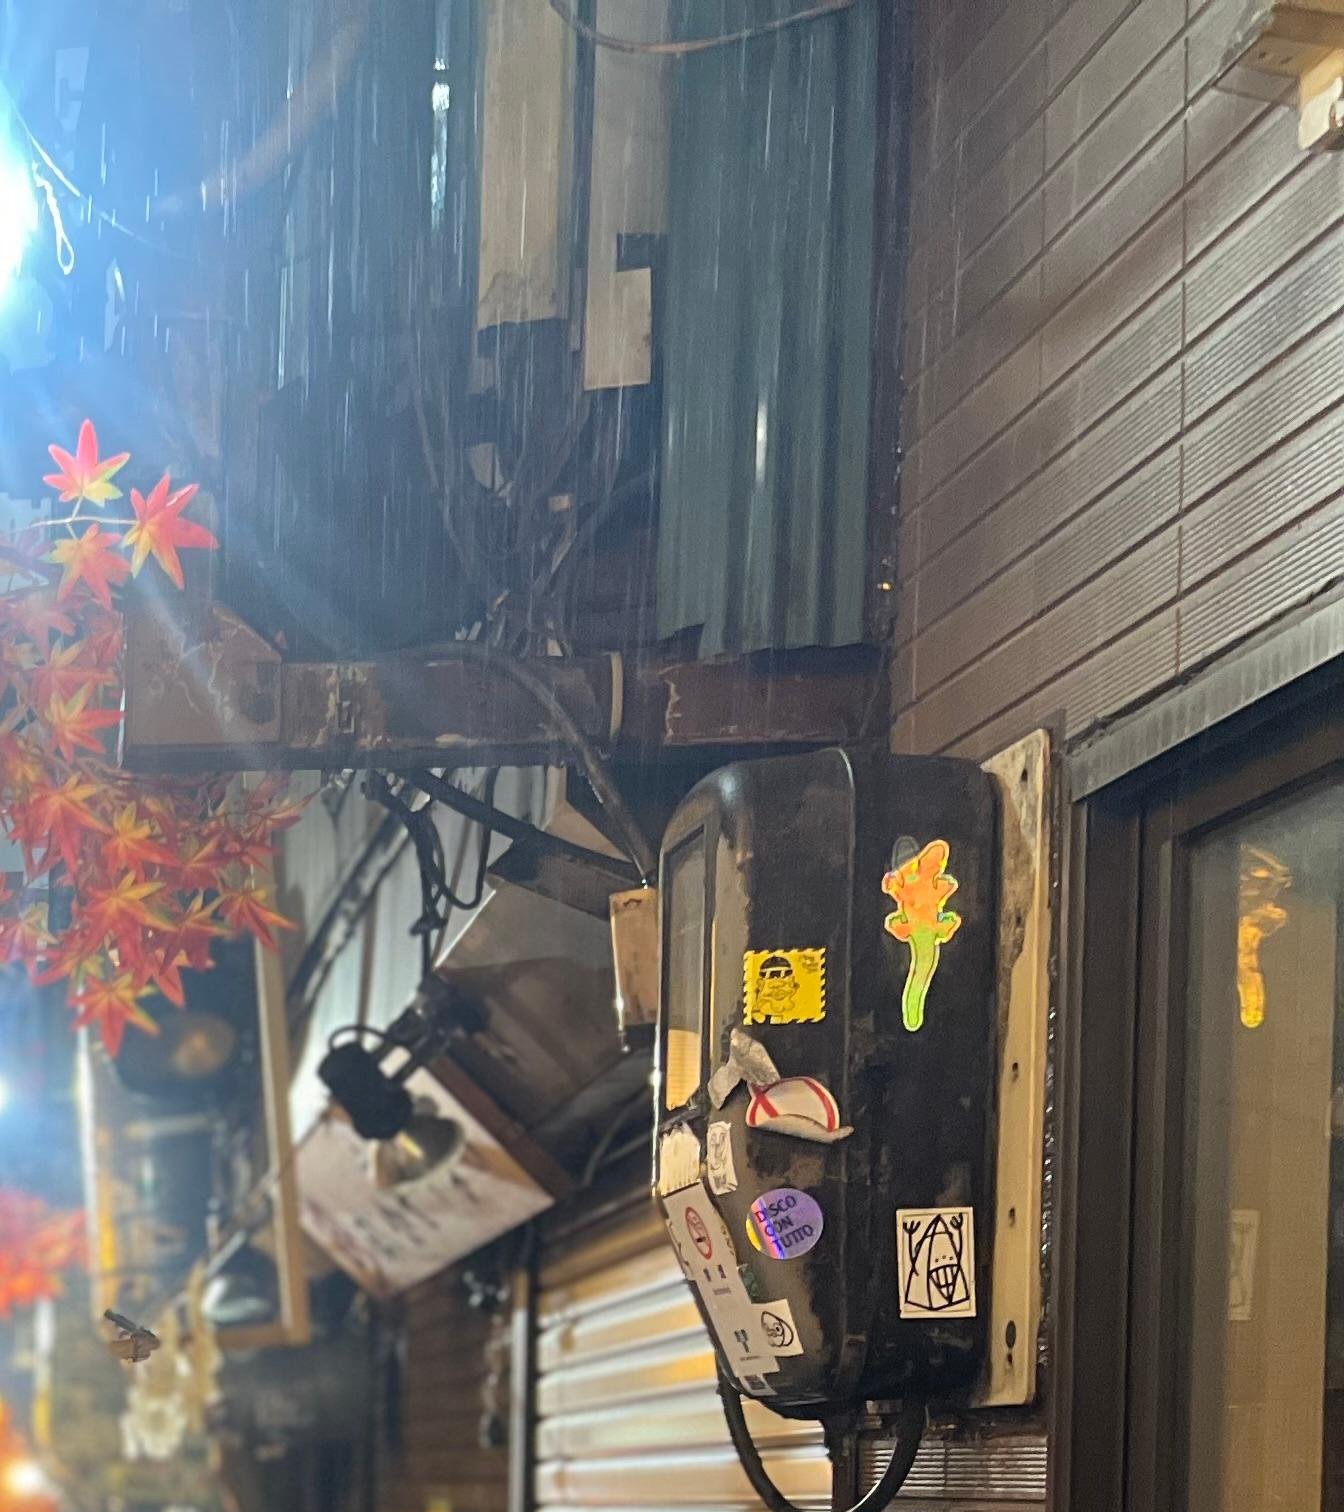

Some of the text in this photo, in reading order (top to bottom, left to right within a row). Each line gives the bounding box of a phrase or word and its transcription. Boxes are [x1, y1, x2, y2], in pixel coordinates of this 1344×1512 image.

[755, 1195, 797, 1223] DISCO
[764, 1216, 794, 1237] CON
[771, 1224, 814, 1252] TUTTO
